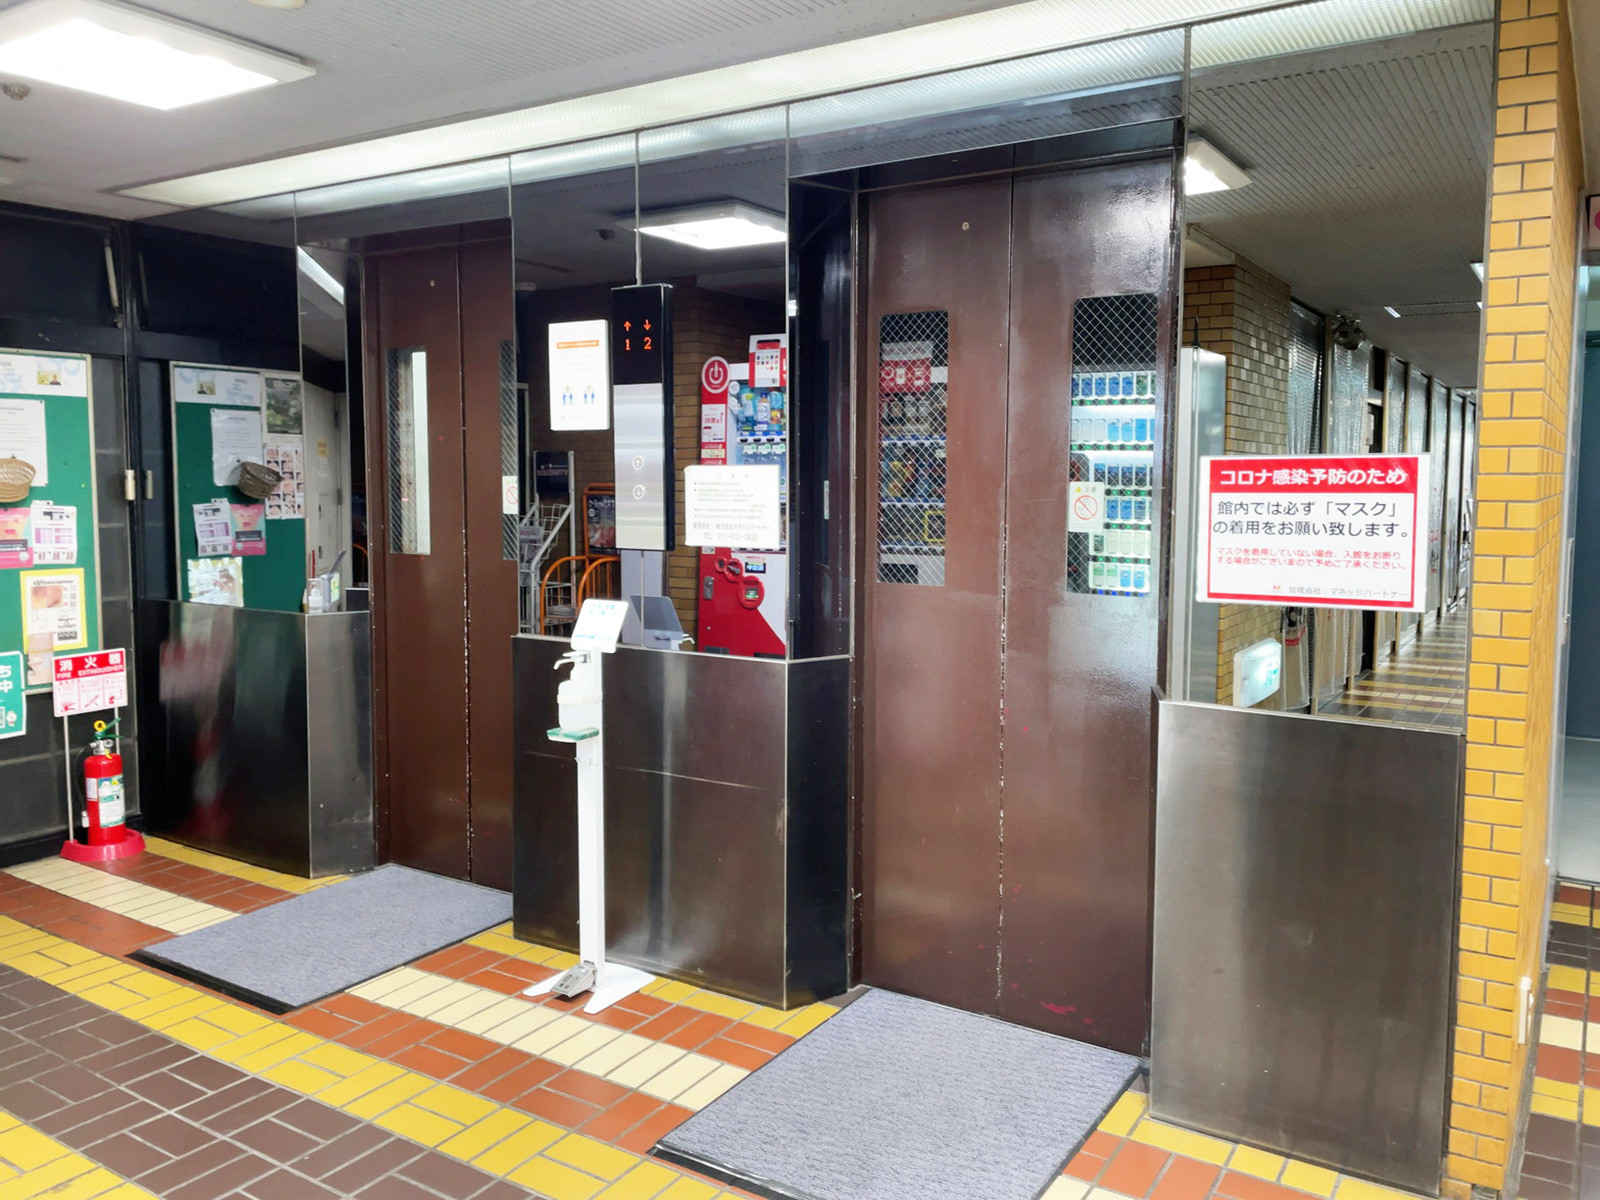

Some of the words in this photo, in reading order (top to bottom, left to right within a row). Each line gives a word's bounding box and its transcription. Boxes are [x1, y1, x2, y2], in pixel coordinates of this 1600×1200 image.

[625, 338, 631, 350] 1
[643, 336, 652, 350] 2
[1220, 468, 1406, 486] コロナ感染予防のため
[1217, 500, 1397, 518] 館内では必ず「マスク」
[1212, 520, 1408, 538] の着用をお願い致します。
